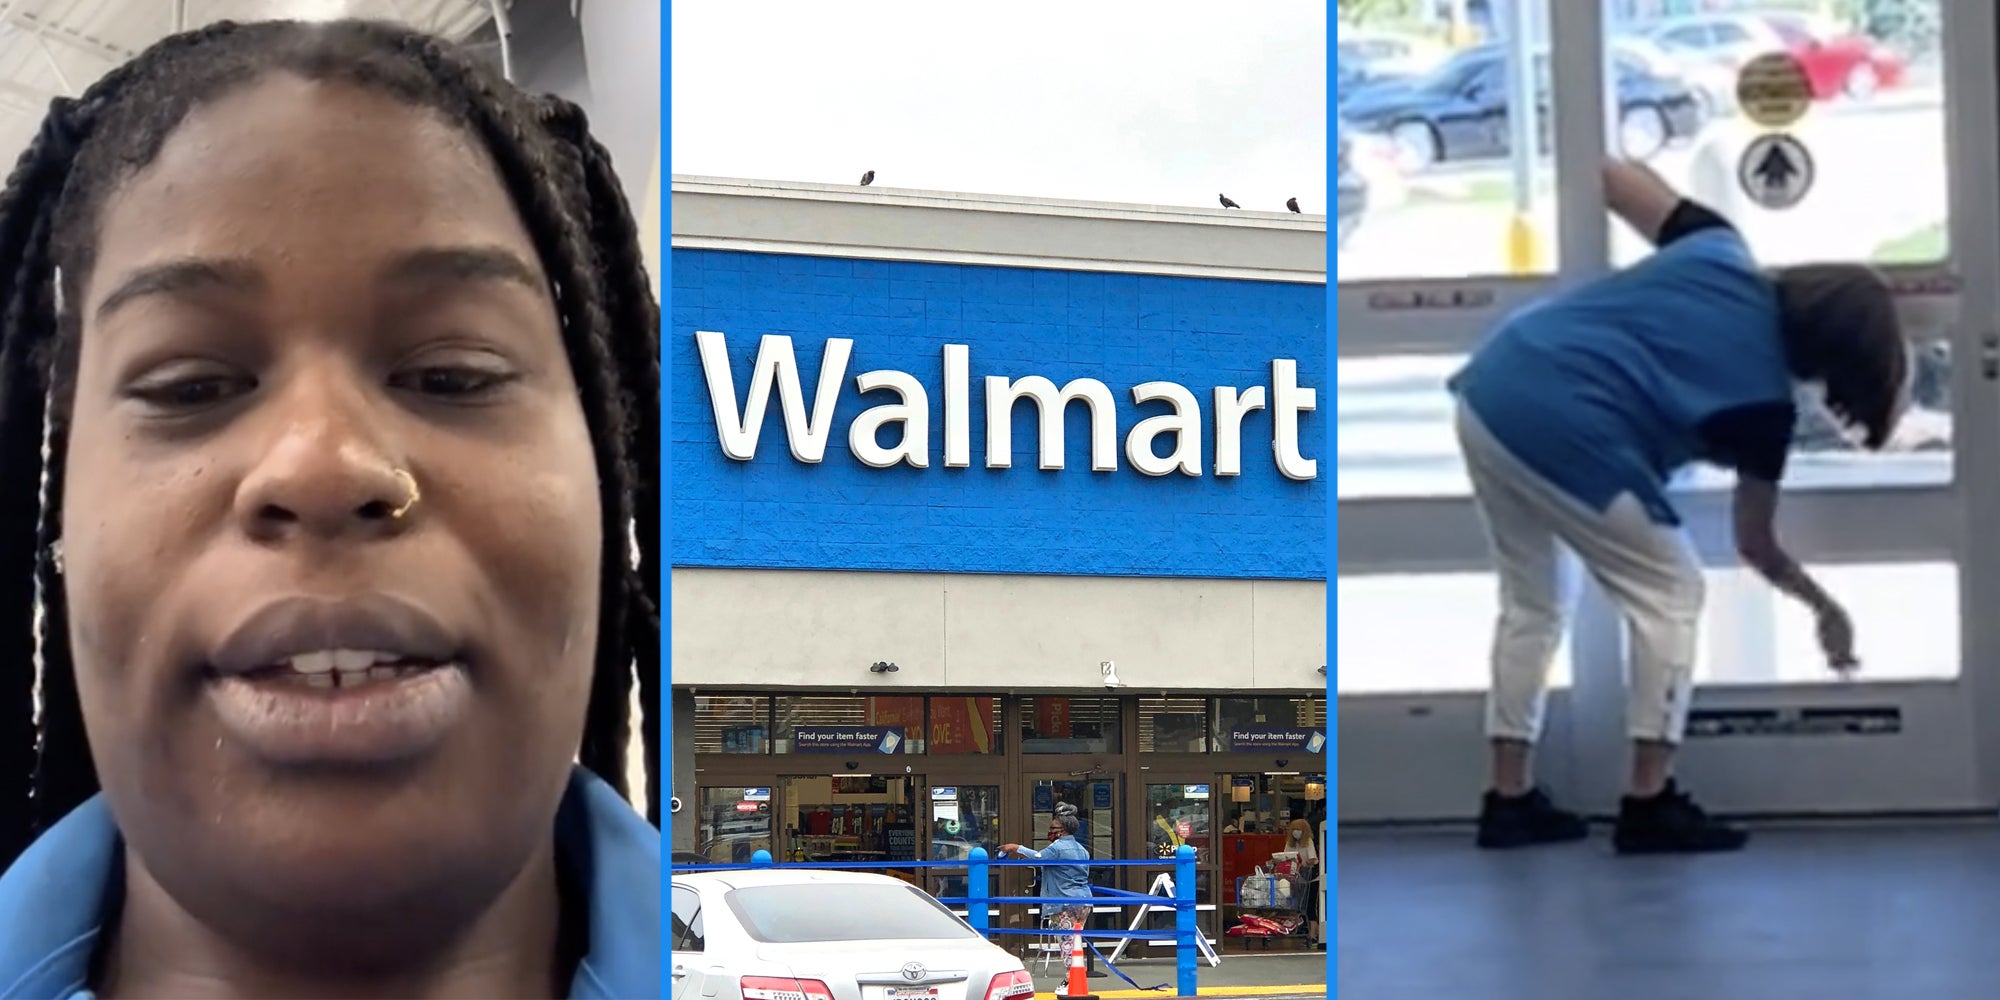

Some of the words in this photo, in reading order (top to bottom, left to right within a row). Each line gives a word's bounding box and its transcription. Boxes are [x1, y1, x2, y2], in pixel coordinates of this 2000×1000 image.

[695, 331, 1317, 480] Walmart
[798, 732, 815, 740] Find
[818, 733, 834, 742] your
[836, 732, 853, 740] item
[855, 732, 878, 740] faster
[1233, 732, 1249, 740] Find
[1251, 733, 1266, 742] your
[1268, 732, 1284, 740] item
[1285, 732, 1306, 740] faster
